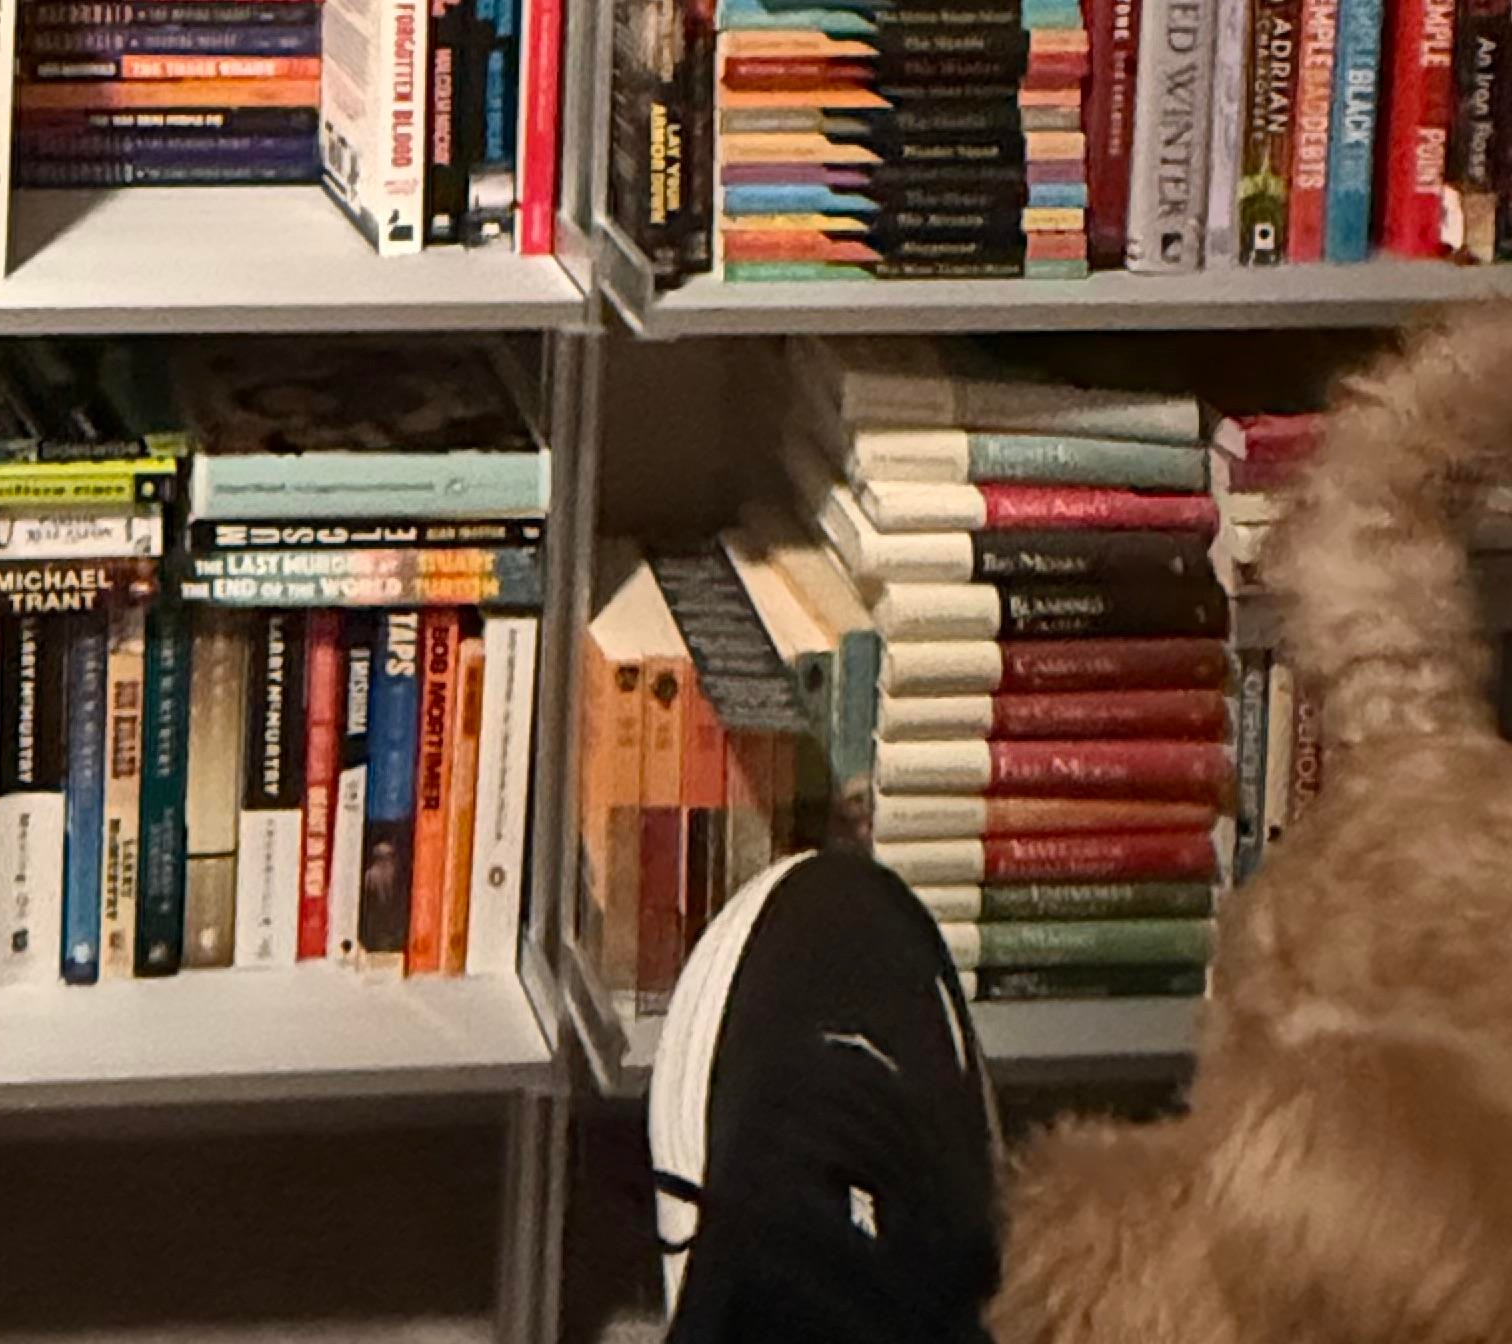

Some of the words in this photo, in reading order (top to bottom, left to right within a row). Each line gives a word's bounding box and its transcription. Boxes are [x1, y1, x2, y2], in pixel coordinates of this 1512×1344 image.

[1267, 18, 1292, 134] ADRIAN
[1157, 63, 1192, 220] WINTER
[10, 590, 95, 611] TRANT
[428, 628, 451, 675] BOB
[424, 682, 449, 811] MORTIMER
